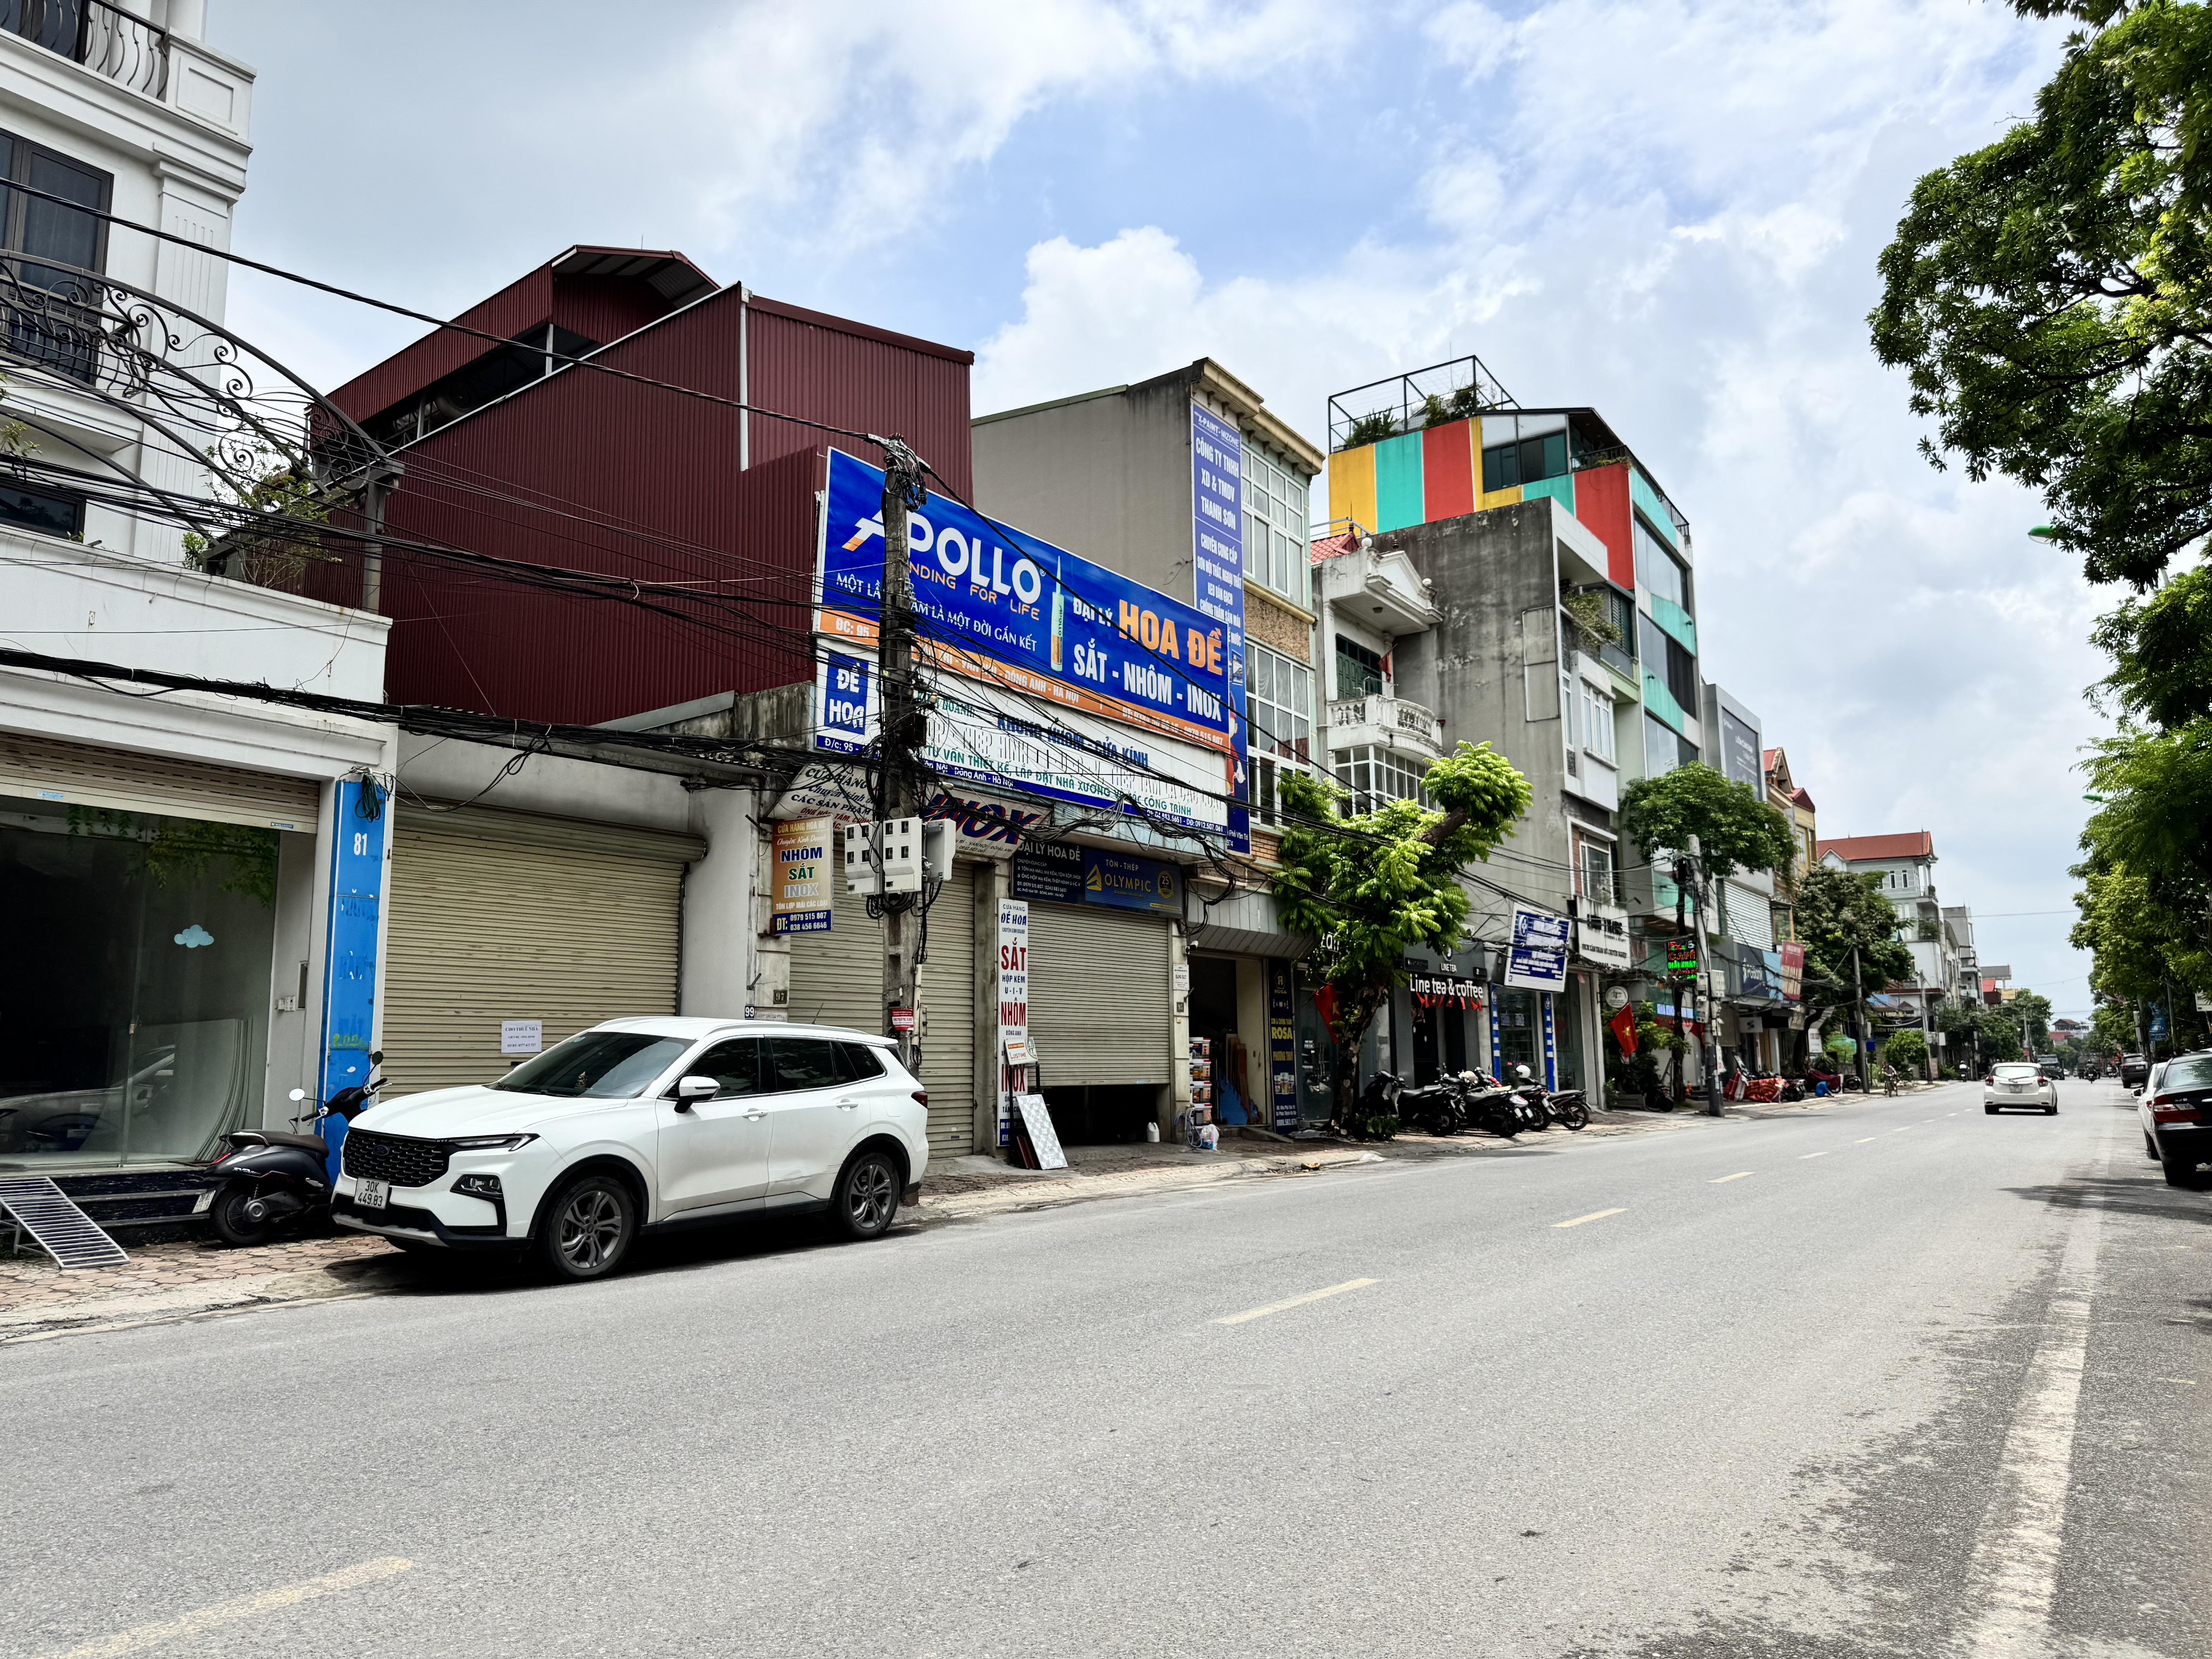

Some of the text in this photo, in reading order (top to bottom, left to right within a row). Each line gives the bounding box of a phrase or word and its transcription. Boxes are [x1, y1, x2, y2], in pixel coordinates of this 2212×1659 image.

[1196, 437, 1239, 478] CÔNG TY TNHH
[1201, 468, 1235, 502] XD & TMDV
[1201, 496, 1236, 530] THANH SƠN
[1200, 533, 1238, 565] CHUYÊN CUNG CẤP
[1197, 556, 1205, 571] SƠN
[970, 584, 1039, 620] FOR LIFE
[836, 573, 864, 593] MỘT
[947, 611, 971, 630] MỘT
[973, 619, 991, 637] ĐỜI
[994, 627, 1017, 645] GẮN
[1020, 633, 1037, 651] KẾT
[1073, 598, 1095, 622] ĐẠI
[1119, 599, 1179, 659] HOA
[1187, 627, 1223, 676] ĐỀ
[857, 624, 869, 637] 95
[1029, 678, 1046, 693] ANH
[1074, 638, 1222, 722] SẮT NHÔM INOX
[829, 698, 865, 729] HOA
[824, 738, 1014, 788] Đ/c: 95 Đông Anh Hà Nội
[1122, 746, 1148, 767] KÍNH
[944, 747, 964, 764] VẤN
[1016, 764, 1032, 779] LẮP
[1036, 769, 1053, 785] ĐẶT
[1144, 796, 1167, 811] CÔNG
[1170, 800, 1191, 816] TRÌNH
[791, 795, 840, 811] CÁC SẢN
[778, 821, 788, 833] CỬA
[790, 820, 805, 832] HÀNG
[806, 821, 817, 830] HOA
[1195, 821, 1223, 832] 0912.507.061
[354, 832, 368, 856] 81
[810, 834, 826, 842] Doanh
[781, 846, 823, 862] NHÔM
[1036, 842, 1045, 855] LÝ
[1048, 845, 1067, 859] HOA
[788, 863, 814, 880] SẮT
[1106, 859, 1139, 871] TÔN THÉP
[1105, 873, 1151, 892] OLYMPIC
[1162, 876, 1169, 885] 25
[785, 883, 818, 898] INOX
[817, 899, 828, 908] LOẠI
[777, 917, 788, 931] ĐT:
[1013, 914, 1027, 925] HOA
[1001, 937, 1026, 971] SẮT
[1002, 974, 1013, 984] HỘP
[1410, 974, 1483, 999] Line tea & coffee
[776, 993, 785, 1001] 97
[1001, 997, 1026, 1027] NHÔM
[1271, 1027, 1293, 1039] ROSA
[365, 1180, 378, 1193] 30K
[358, 1193, 383, 1207] 449.83
